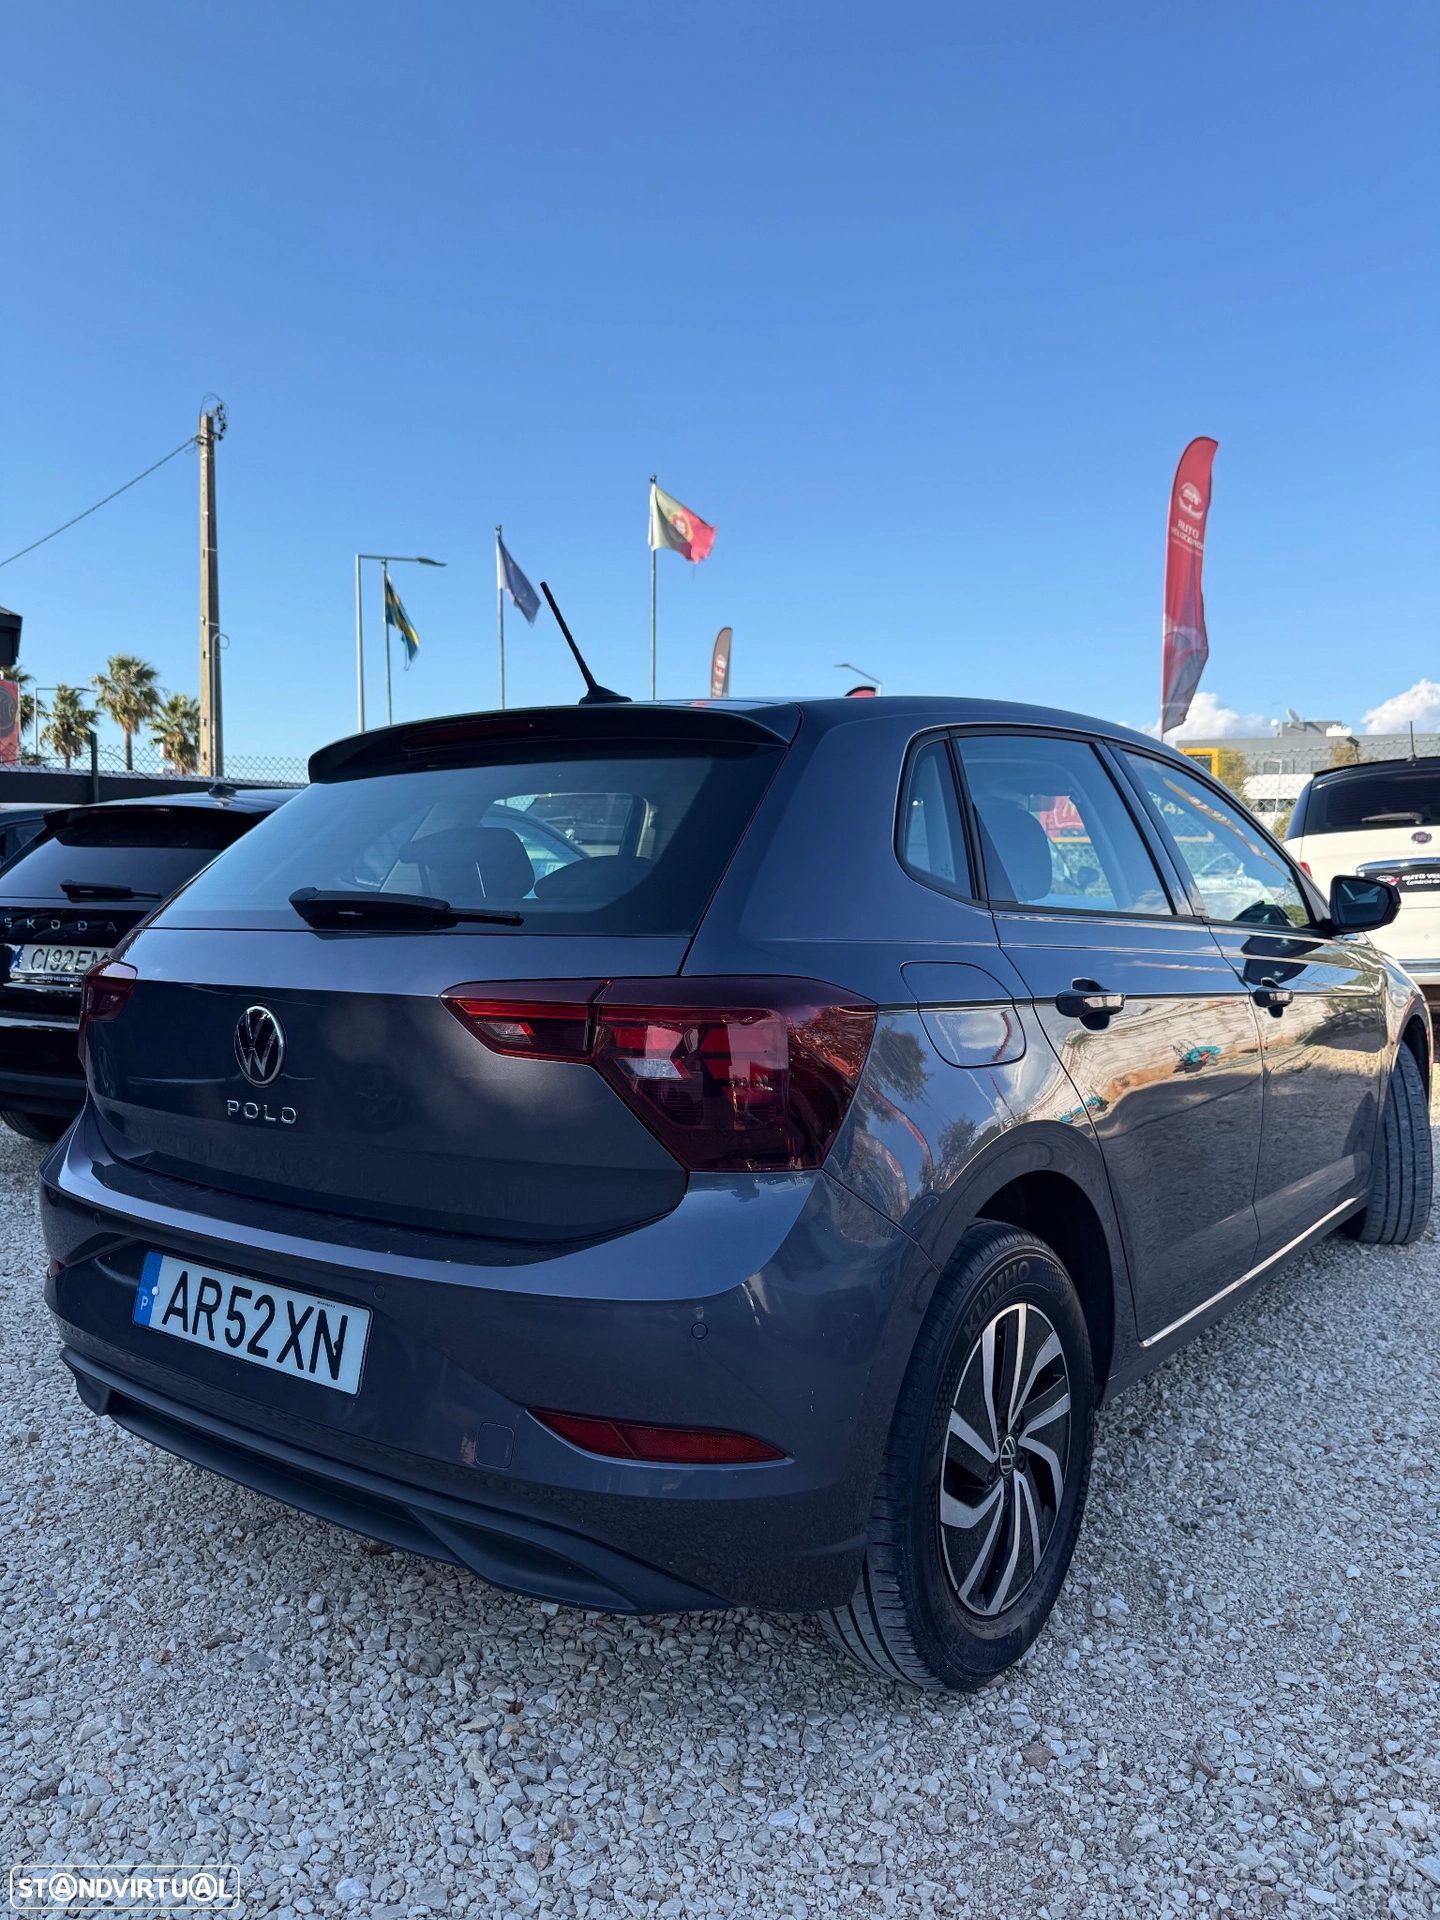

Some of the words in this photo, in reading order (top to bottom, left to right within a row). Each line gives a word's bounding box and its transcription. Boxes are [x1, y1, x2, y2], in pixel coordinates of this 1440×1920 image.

[227, 1099, 298, 1125] POLO
[140, 1295, 149, 1311] P
[963, 1260, 1031, 1342] KUMHO
